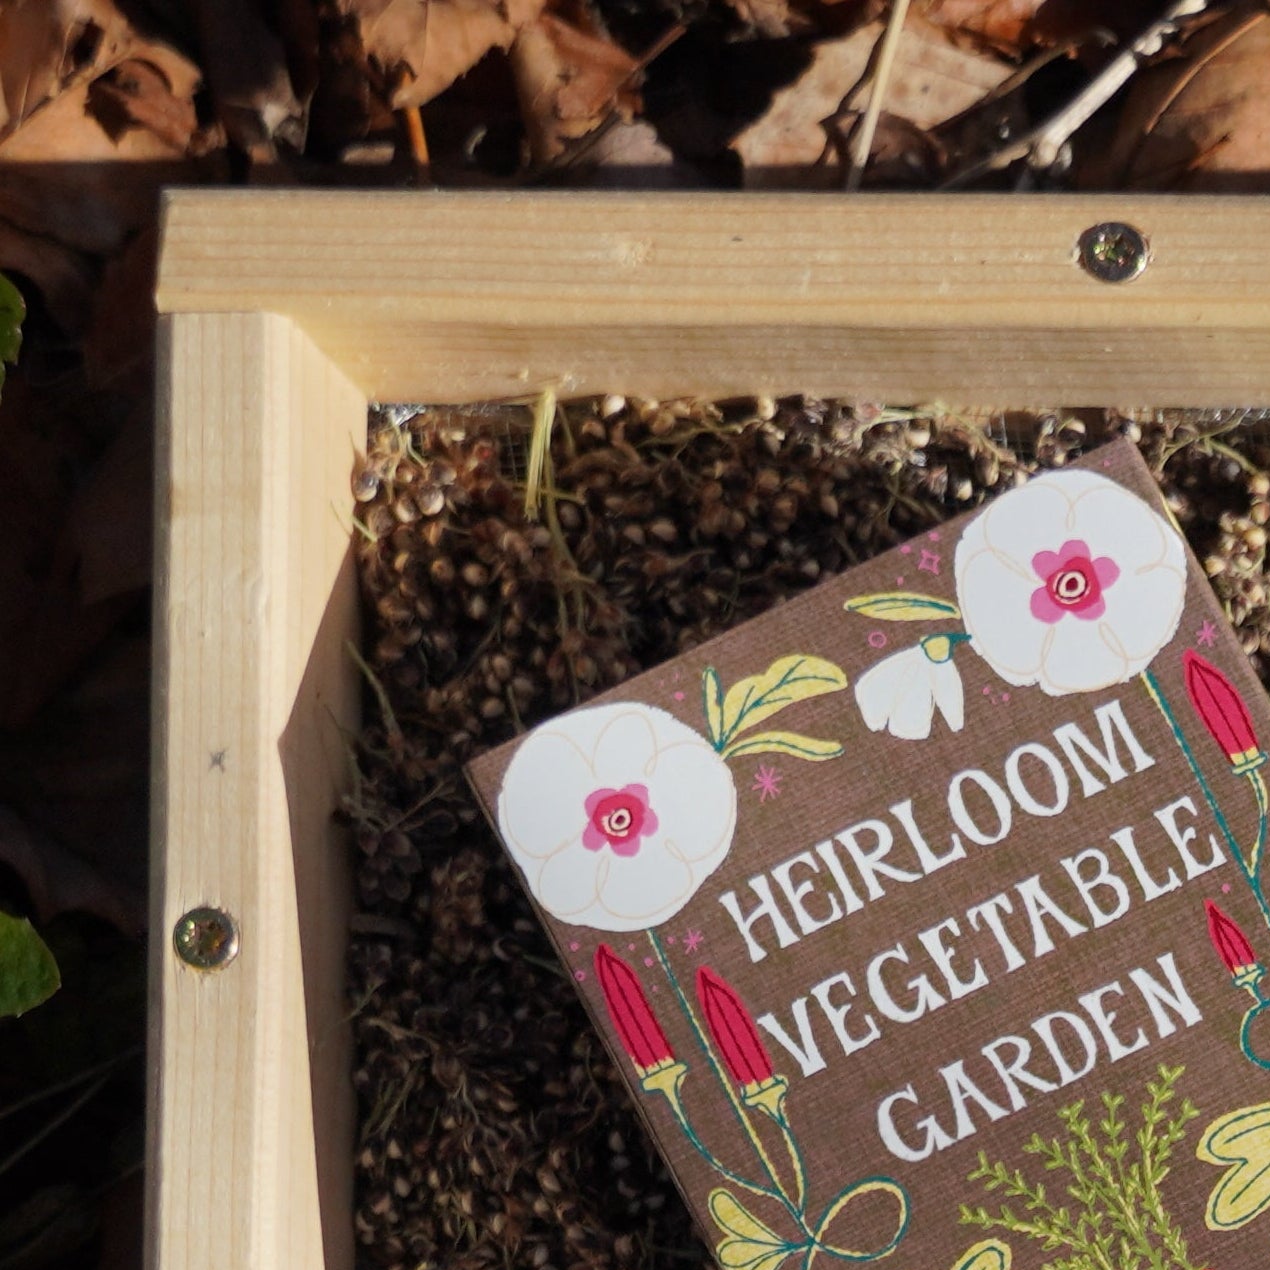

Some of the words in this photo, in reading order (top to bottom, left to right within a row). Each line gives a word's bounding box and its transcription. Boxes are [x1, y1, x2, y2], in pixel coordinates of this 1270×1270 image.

[720, 697, 1158, 966] HEIRLOOM
[757, 794, 1227, 1080] VEGETABLE
[876, 952, 1206, 1164] GARDEN
